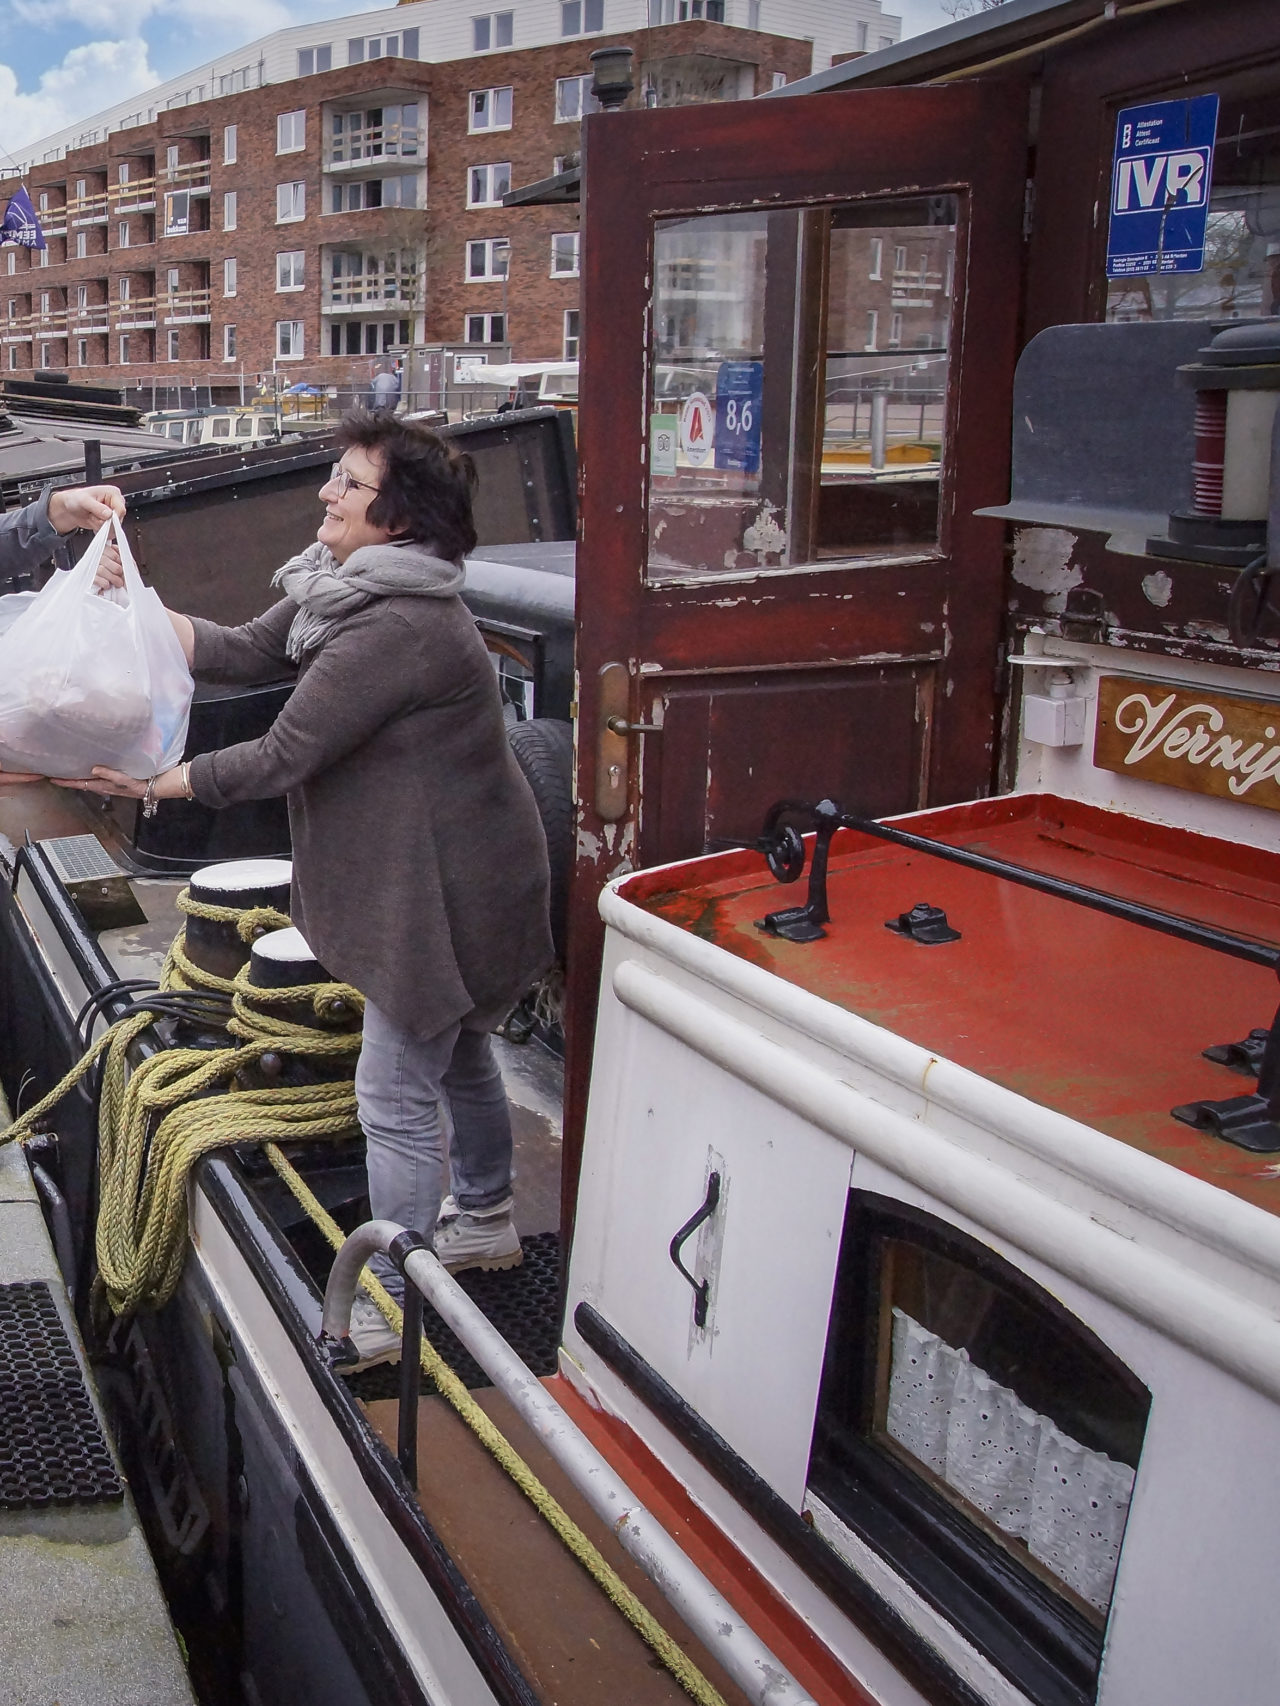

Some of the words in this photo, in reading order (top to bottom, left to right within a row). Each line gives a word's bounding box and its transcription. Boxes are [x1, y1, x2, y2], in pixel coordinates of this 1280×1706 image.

[1135, 130, 1151, 138] Attest
[1117, 152, 1204, 210] IVR
[726, 399, 752, 435] 8,6
